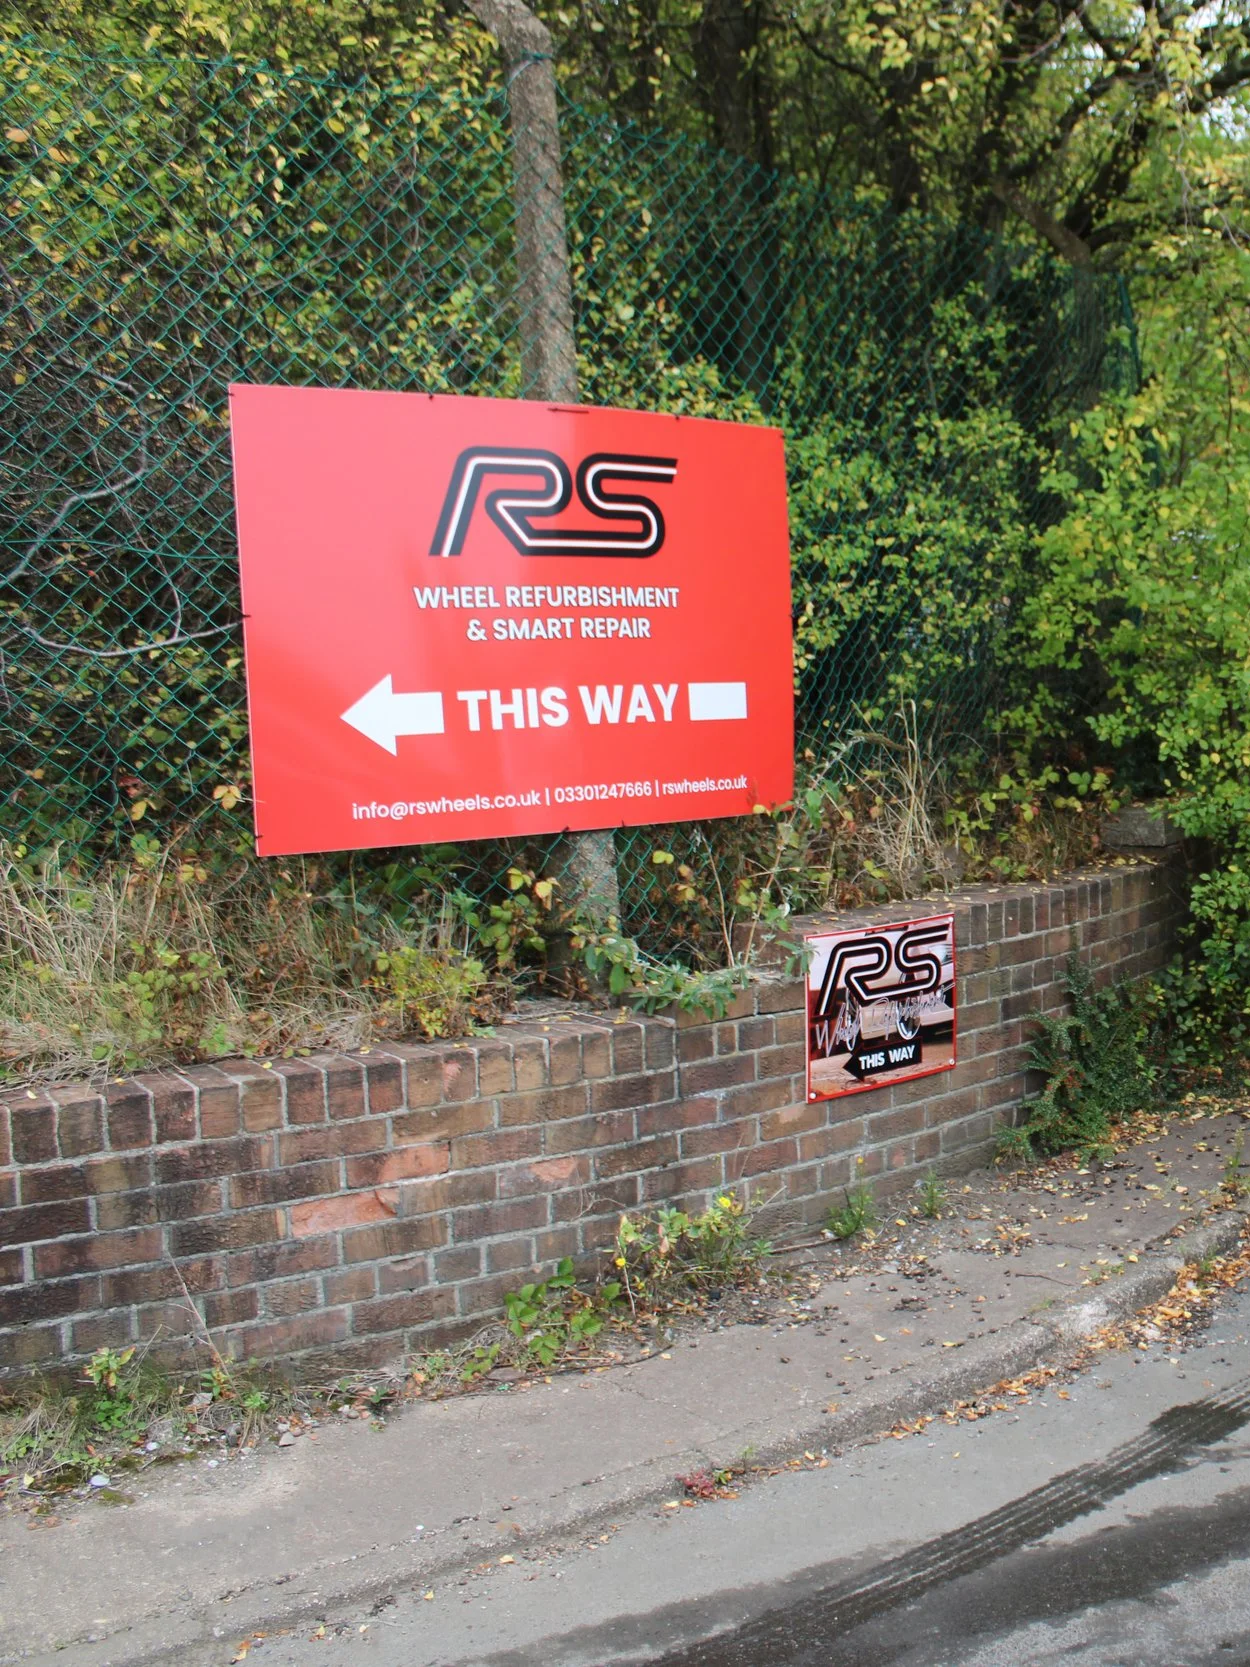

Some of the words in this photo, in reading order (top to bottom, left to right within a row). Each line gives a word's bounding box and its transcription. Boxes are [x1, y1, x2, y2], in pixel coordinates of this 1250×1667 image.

[428, 446, 678, 558] RS
[413, 586, 500, 609] WHEEL
[505, 585, 680, 608] REFURBISHMENT
[466, 619, 488, 641] &
[493, 617, 574, 640] SMART
[580, 617, 651, 639] REPAIR
[456, 686, 570, 732] THIS
[577, 683, 679, 725] WAY
[352, 788, 541, 821] info@rswheels.co.uk
[554, 780, 652, 804] 03301247666
[662, 774, 748, 796] rswheels.co.uk
[815, 922, 951, 1016] RS
[859, 1052, 885, 1070] THIS
[889, 1045, 916, 1063] WAY
